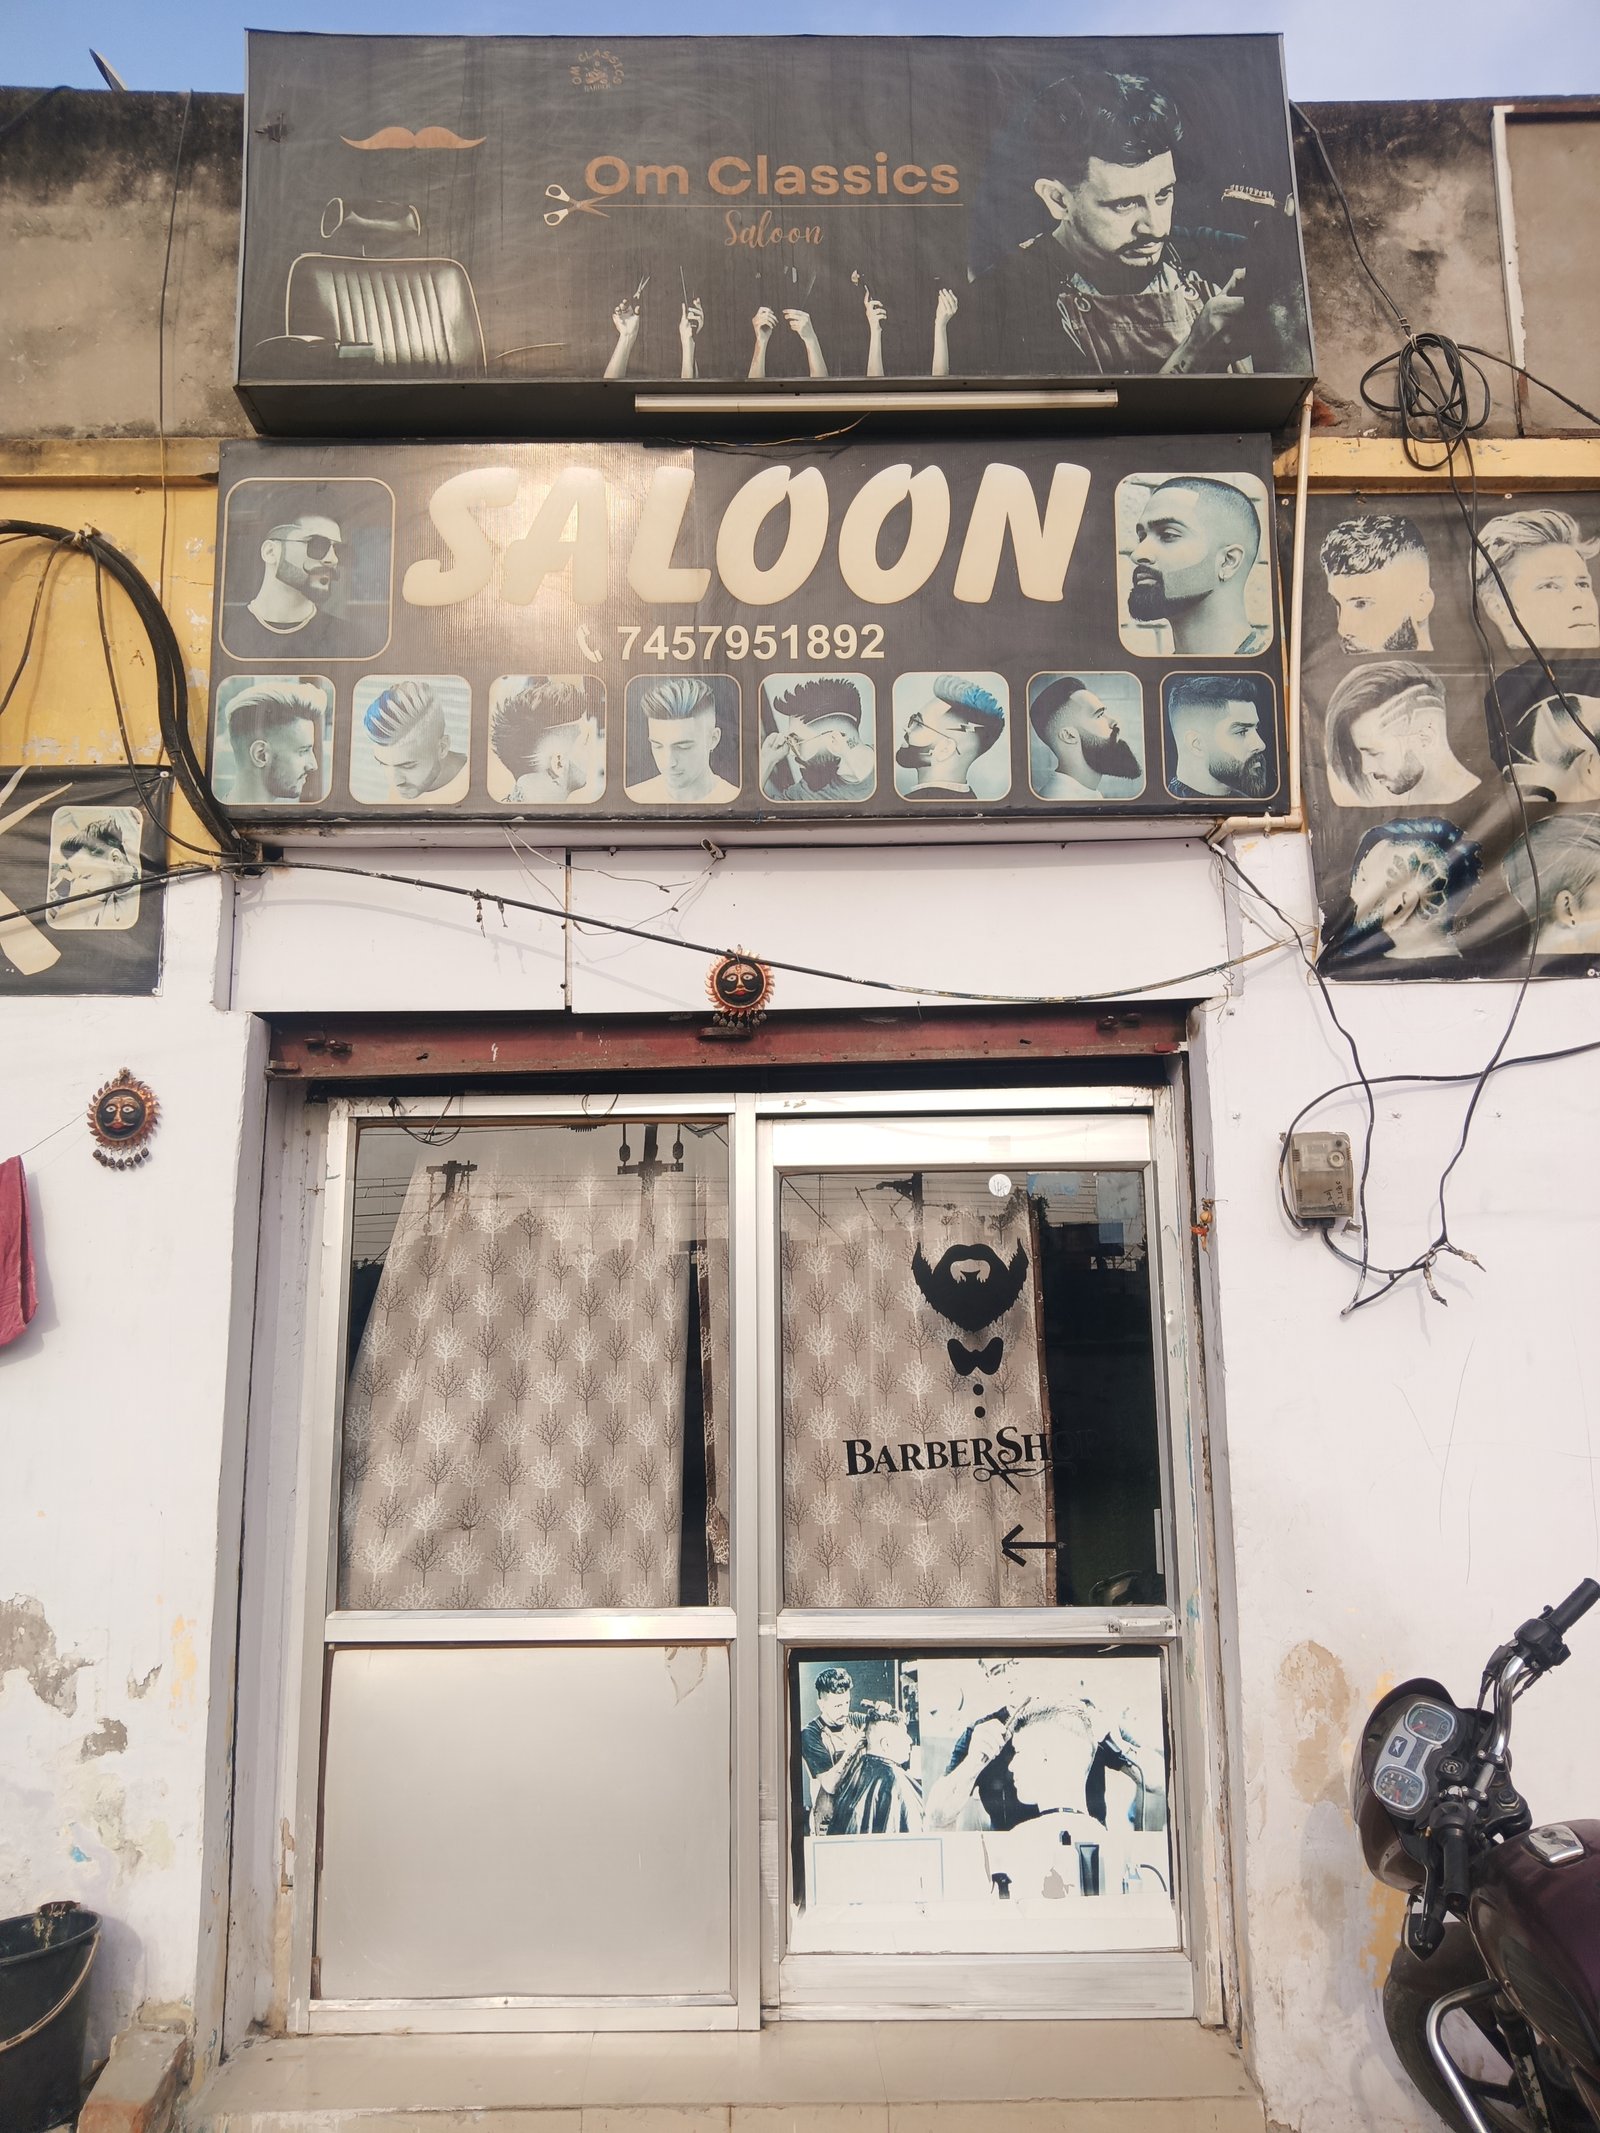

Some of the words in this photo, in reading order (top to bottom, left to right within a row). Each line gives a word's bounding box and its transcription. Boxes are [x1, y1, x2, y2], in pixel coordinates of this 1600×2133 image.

[585, 155, 689, 195] Om
[707, 151, 960, 196] Classics
[723, 209, 824, 248] Saloon
[402, 463, 1091, 606] SALOON
[617, 624, 885, 662] 7457951892
